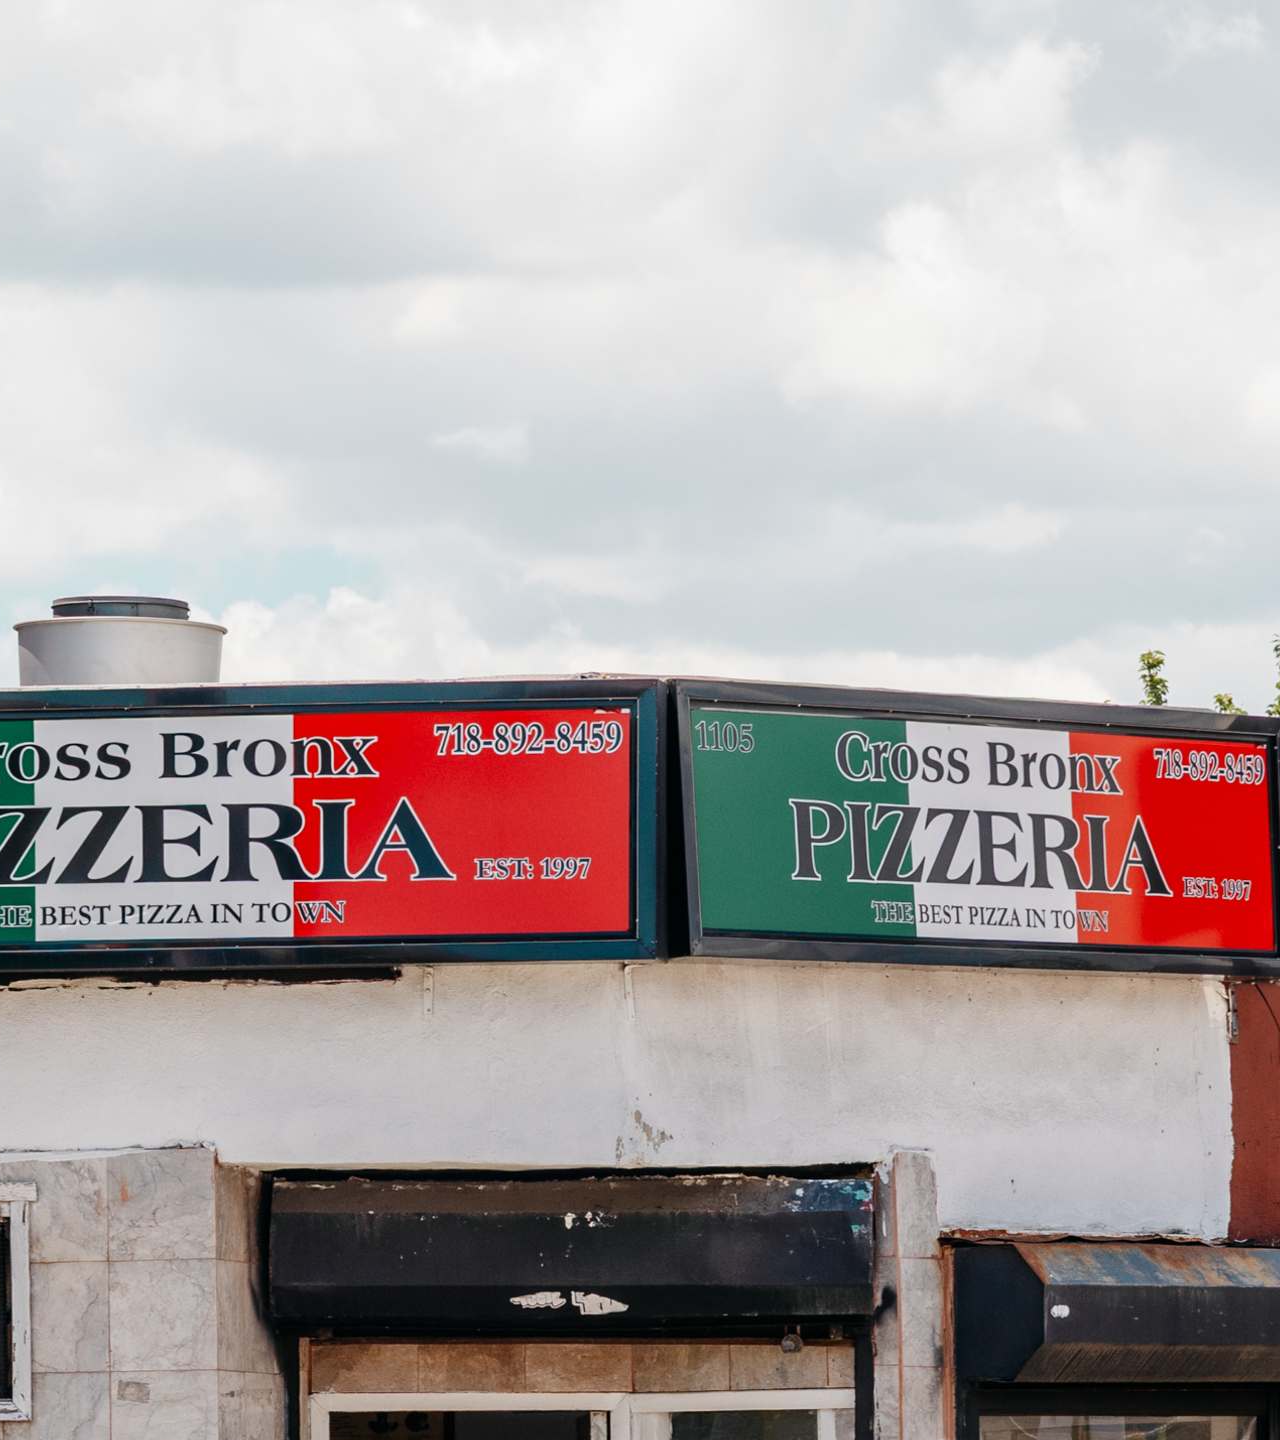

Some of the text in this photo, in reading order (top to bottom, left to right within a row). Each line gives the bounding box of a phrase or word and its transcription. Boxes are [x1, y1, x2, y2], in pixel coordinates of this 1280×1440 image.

[159, 731, 379, 779] Bronx
[433, 720, 623, 756] 718-892-8459
[694, 721, 1265, 796] 1105 Cross Bronx 718-892-8459
[788, 798, 1173, 898] PIZZERIA
[474, 857, 592, 880] EST: 1997
[1182, 876, 1252, 902] EST: 1997
[40, 905, 111, 925] BEST
[119, 903, 203, 925] PIZZA
[211, 903, 243, 924] IN
[251, 900, 346, 924] TOWN
[871, 900, 1109, 933] THE BEST PIZZA IN TOWN
